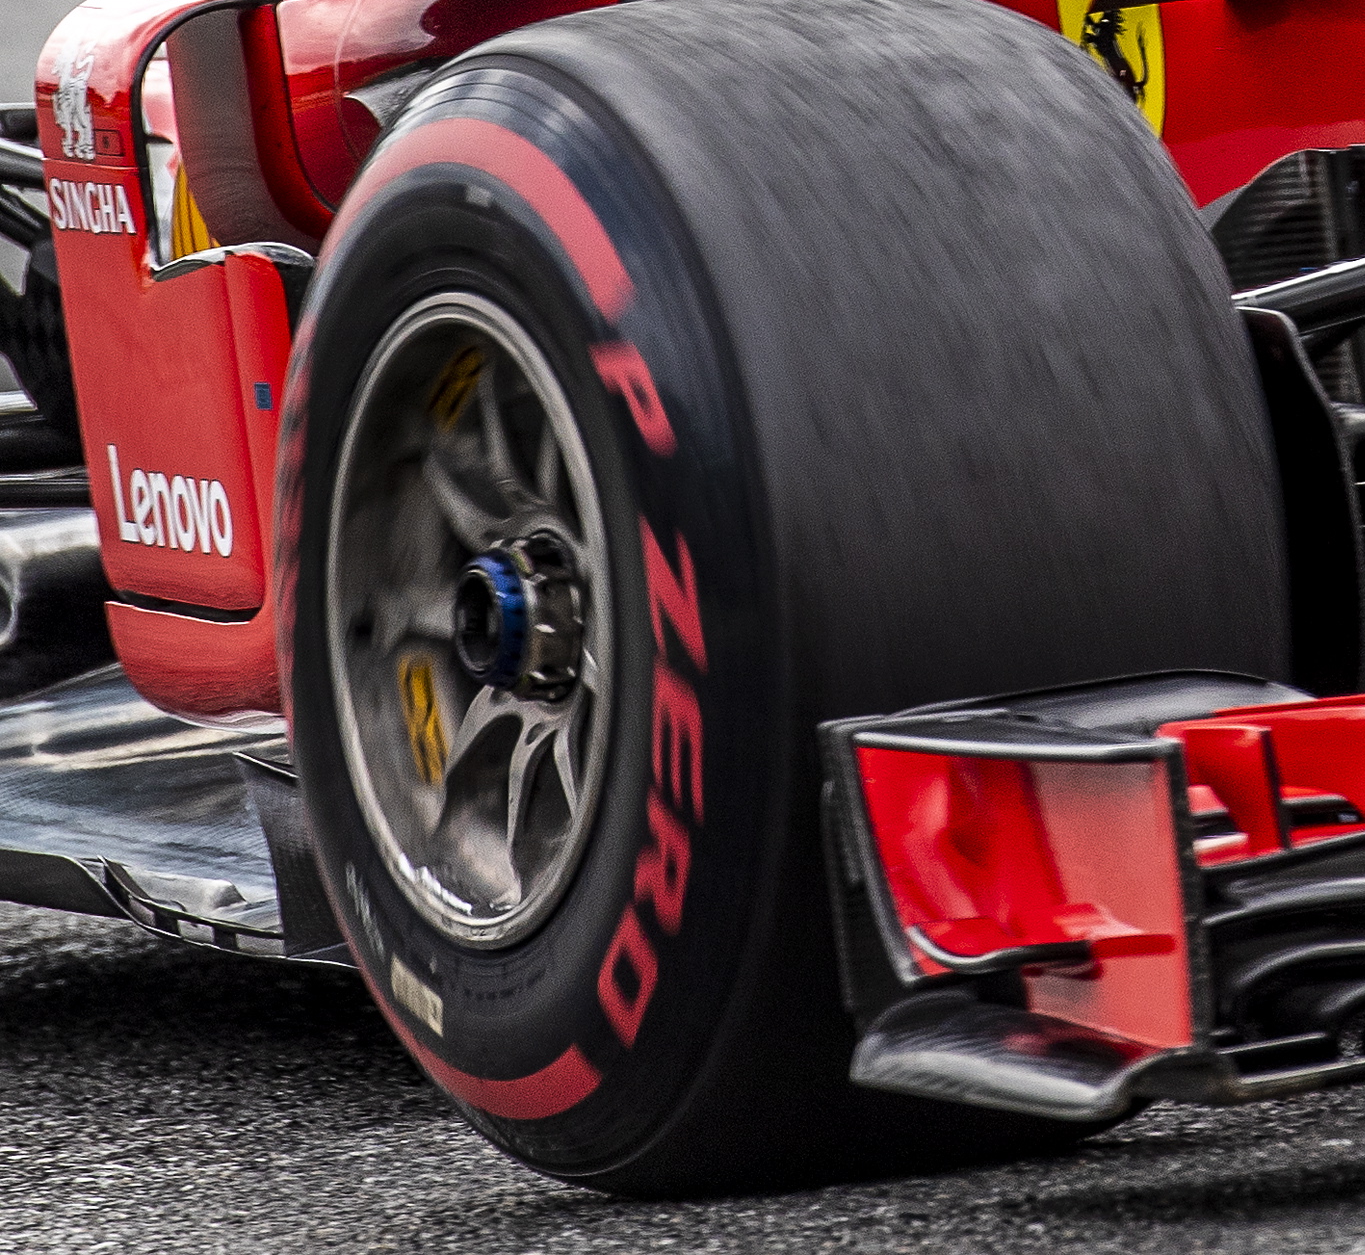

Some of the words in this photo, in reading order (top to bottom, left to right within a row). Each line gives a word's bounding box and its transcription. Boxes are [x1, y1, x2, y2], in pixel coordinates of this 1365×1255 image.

[50, 177, 138, 235] SINGHA
[588, 339, 678, 457] P
[106, 443, 234, 558] Lenovo
[597, 511, 709, 1048] ZERO
